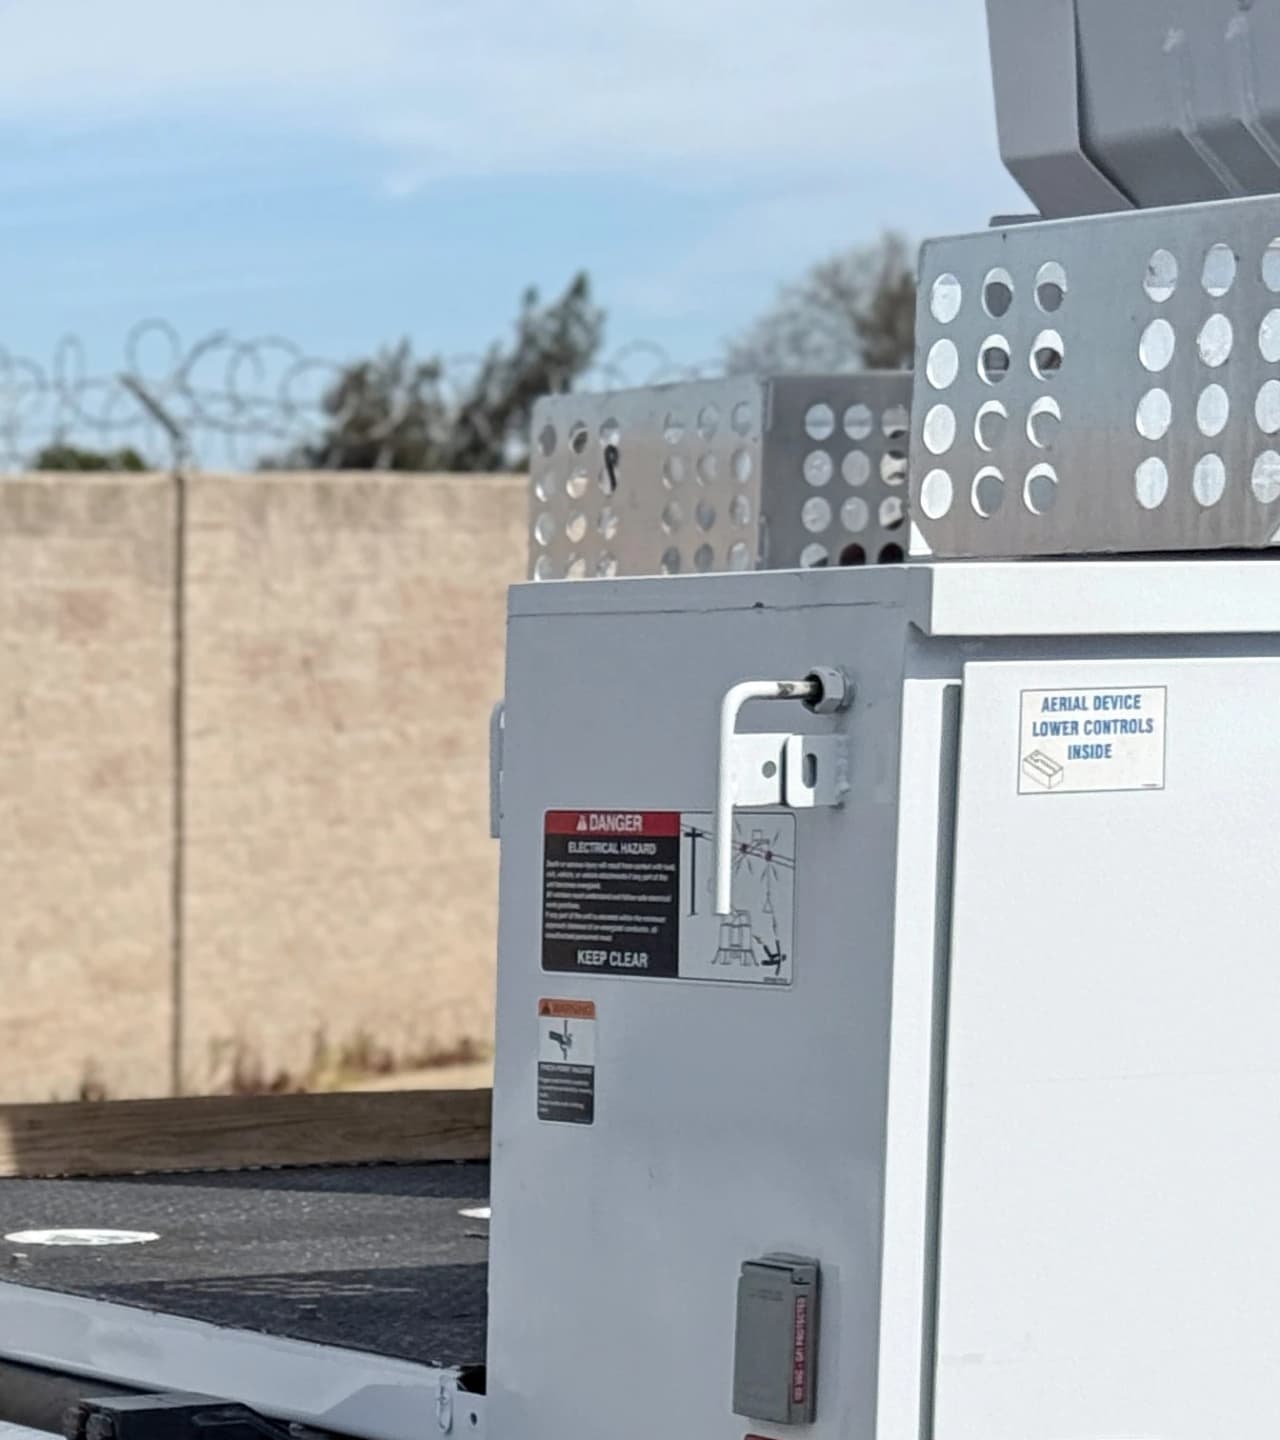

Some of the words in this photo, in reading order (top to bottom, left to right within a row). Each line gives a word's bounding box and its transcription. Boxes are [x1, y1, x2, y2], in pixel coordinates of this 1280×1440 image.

[1041, 696, 1089, 713] AERIAL
[1093, 694, 1141, 711] DEVICE
[1032, 721, 1079, 737] LOWER
[1084, 718, 1154, 736] CONTROLS
[1068, 744, 1113, 760] INSIDE
[589, 814, 643, 832] DANGER
[567, 841, 619, 854] ELECTRICAL
[621, 842, 657, 856] HAZARD
[577, 949, 607, 966] KEEP
[609, 951, 648, 968] CLEAR
